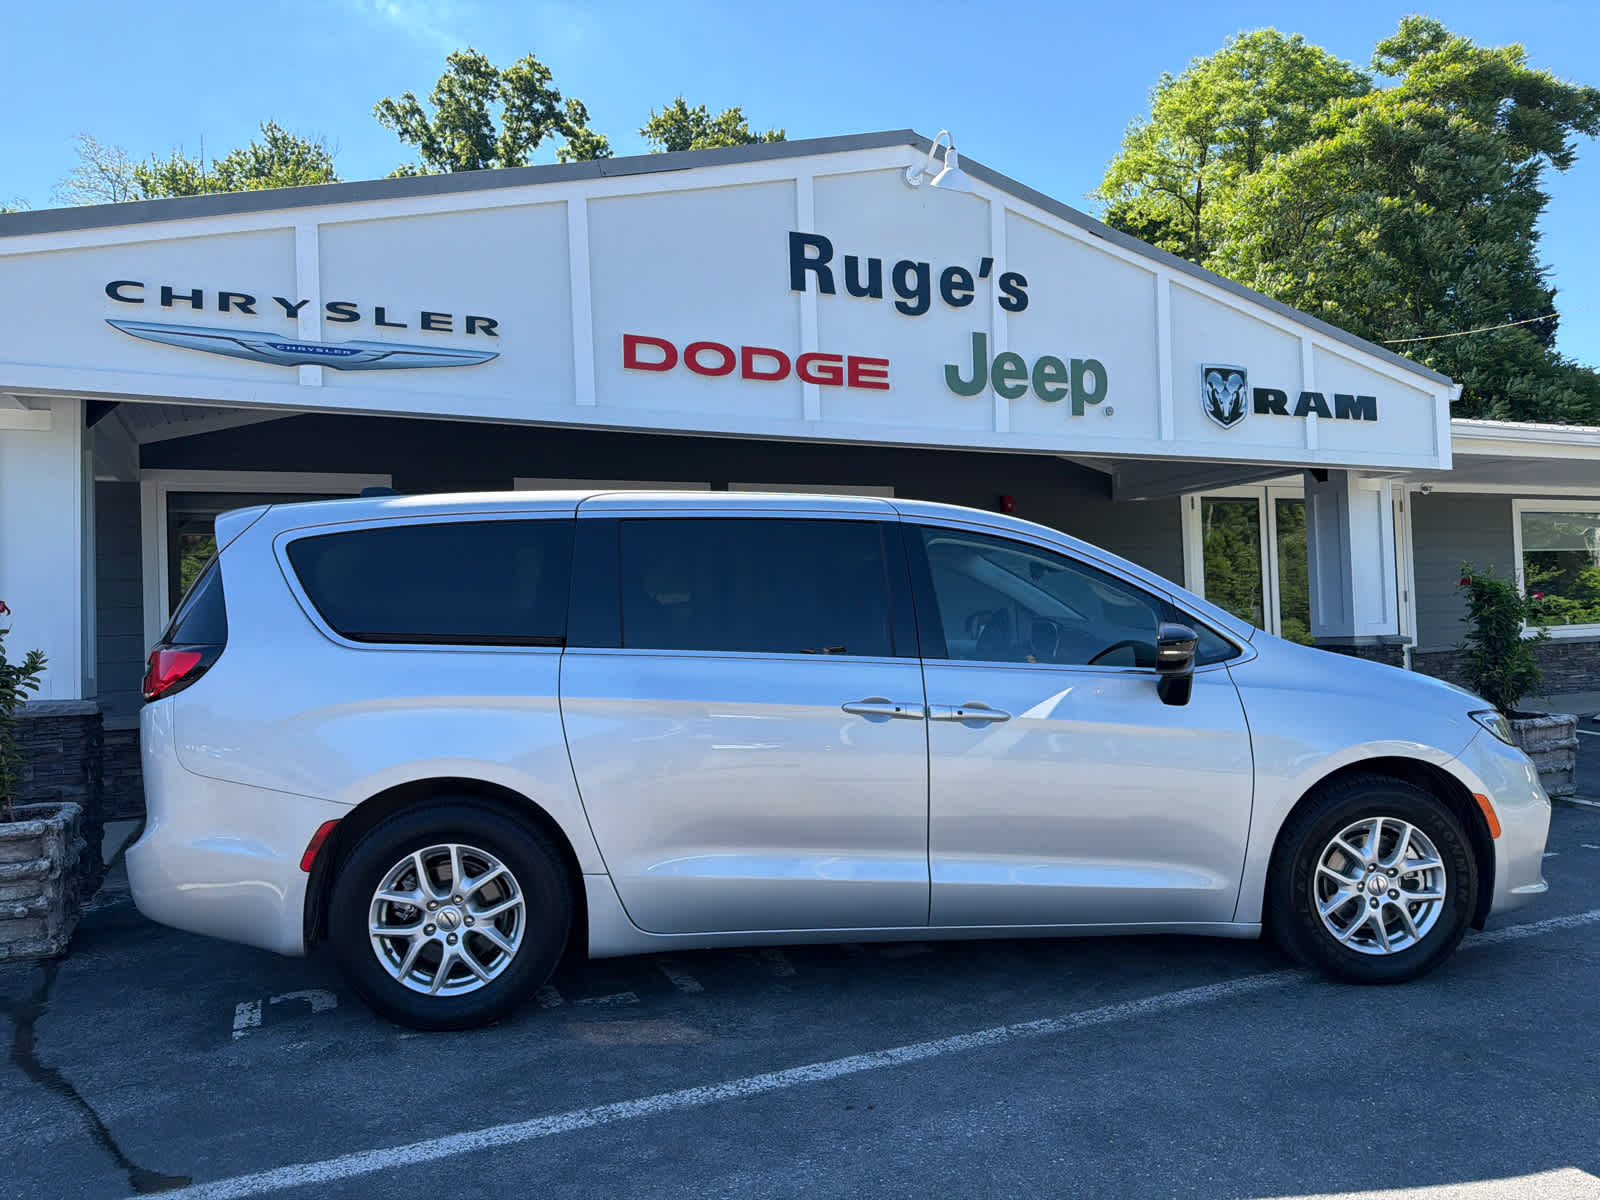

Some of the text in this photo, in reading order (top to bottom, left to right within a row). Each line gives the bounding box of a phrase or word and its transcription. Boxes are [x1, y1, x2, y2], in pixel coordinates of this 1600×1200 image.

[788, 231, 1029, 317] Ruge's
[104, 280, 499, 337] CHRYSLER
[276, 344, 352, 356] CHRYSLER
[623, 333, 890, 391] DODGE
[1252, 387, 1378, 422] RAM
